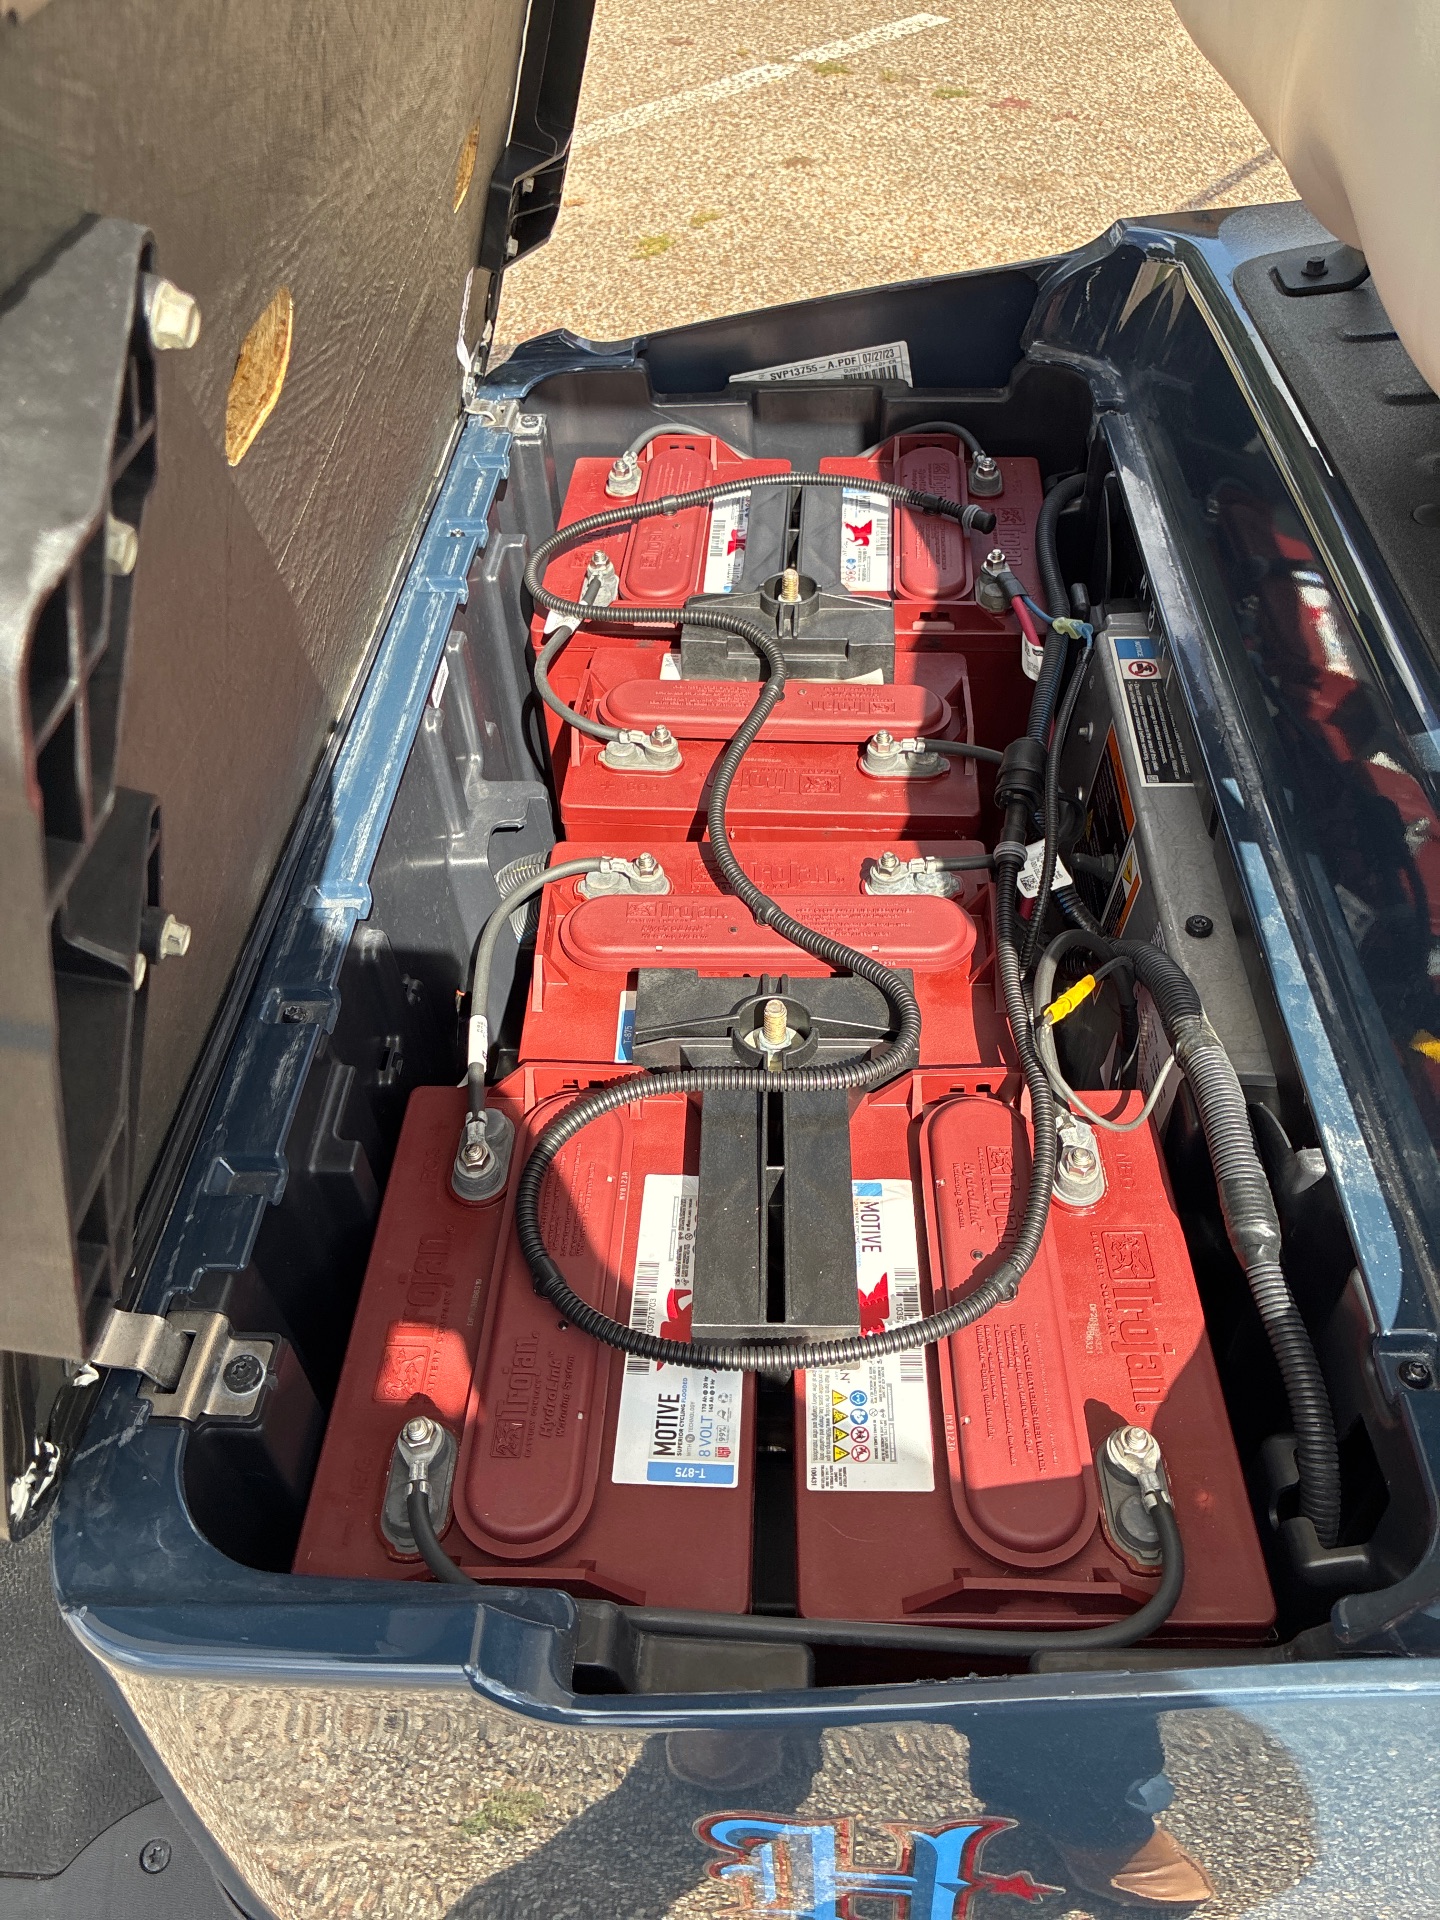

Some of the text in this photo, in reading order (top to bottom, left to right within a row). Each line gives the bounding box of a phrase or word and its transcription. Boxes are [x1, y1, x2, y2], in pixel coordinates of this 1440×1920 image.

[862, 348, 895, 364] 07/27/23
[1133, 640, 1144, 657] NOTICE
[623, 1026, 633, 1044] T-875
[860, 1201, 882, 1253] MOTIVE
[653, 1393, 680, 1456] MOTIVE
[677, 1428, 685, 1457] SUPERIOR
[698, 1415, 713, 1457] 8 VOLT
[719, 1426, 727, 1442] 99%
[717, 1446, 731, 1458] USA
[675, 1466, 706, 1478] T-875
